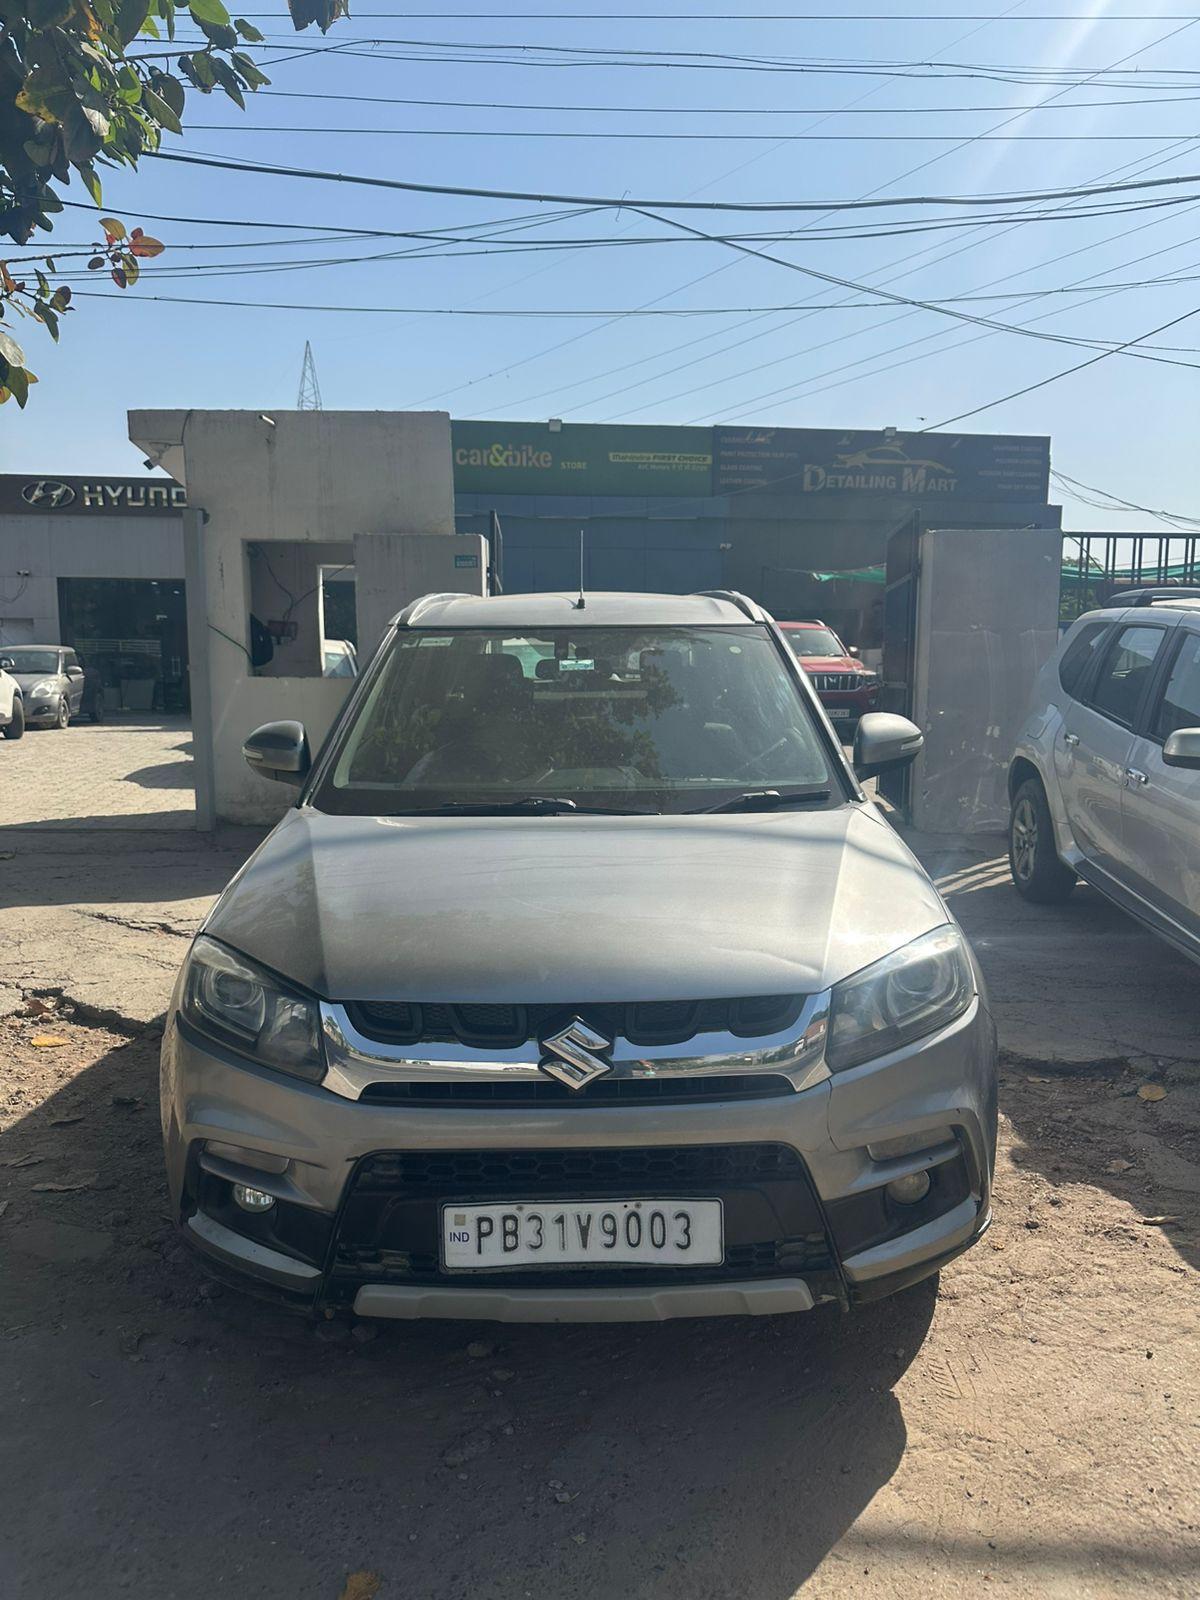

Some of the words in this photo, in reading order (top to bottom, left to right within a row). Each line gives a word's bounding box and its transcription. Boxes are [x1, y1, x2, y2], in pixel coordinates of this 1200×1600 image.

[455, 443, 552, 468] car&bike
[560, 461, 588, 470] STORE
[652, 454, 677, 462] FIRST
[677, 455, 708, 463] CHOICE
[803, 463, 895, 491] DETAILING
[901, 465, 957, 492] MART
[449, 1232, 470, 1242] IND
[476, 1211, 692, 1255] PB31V9003
